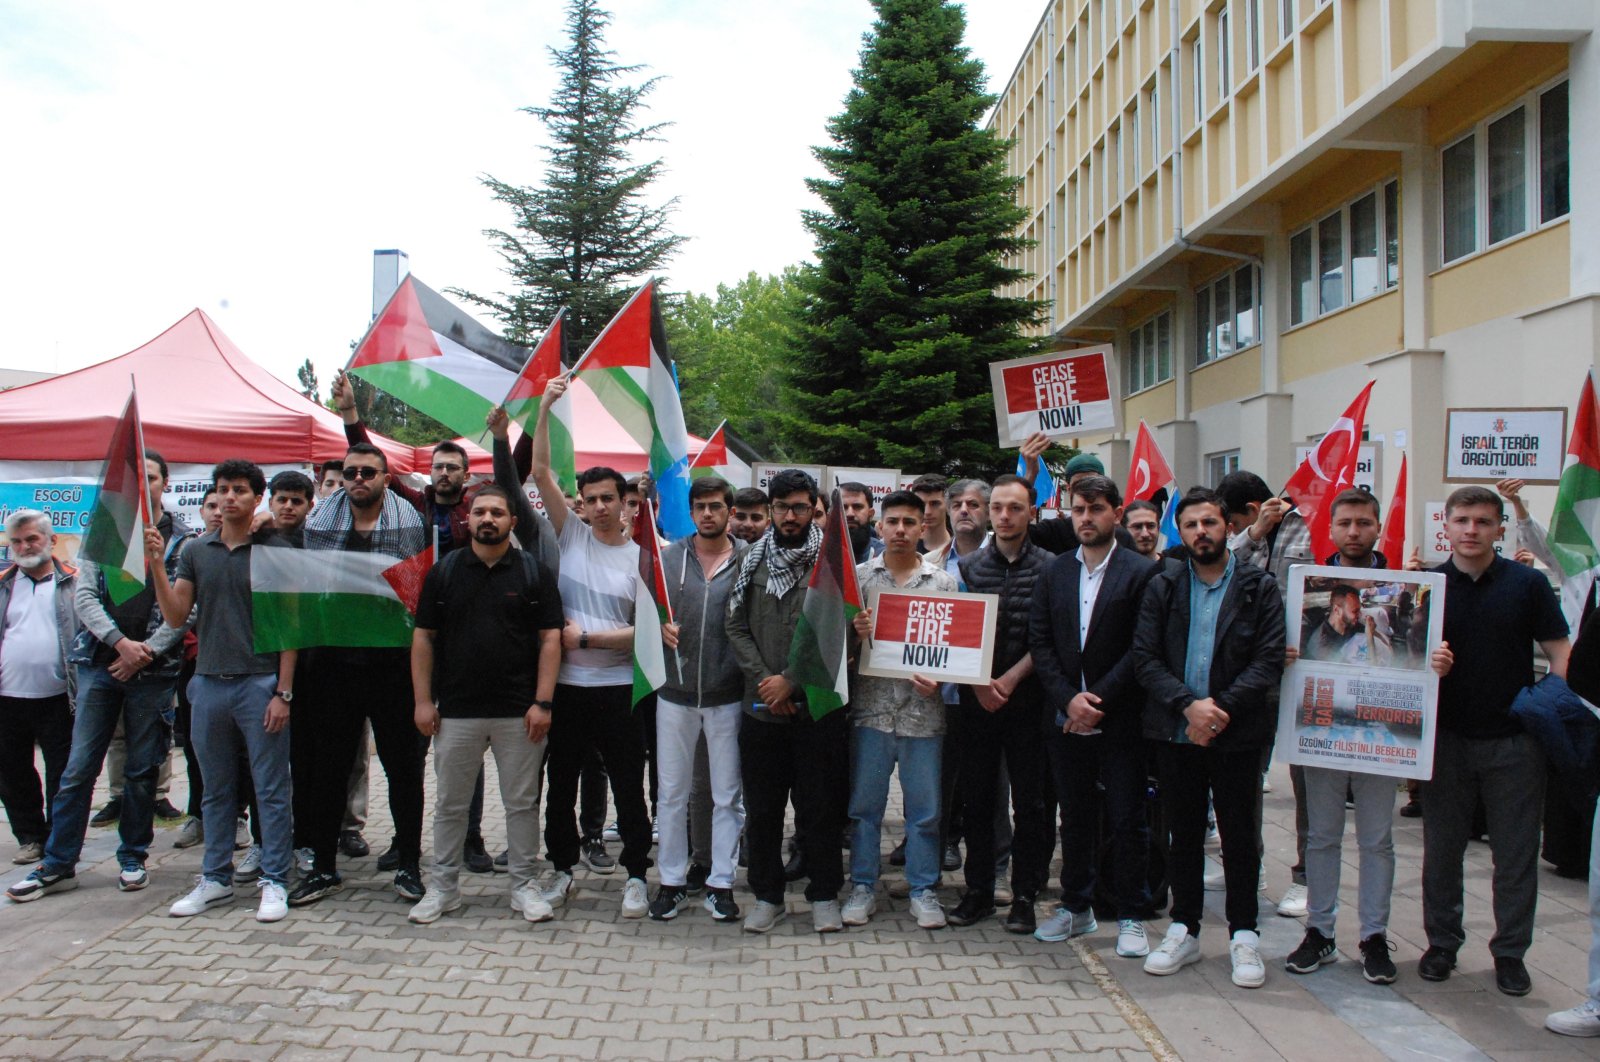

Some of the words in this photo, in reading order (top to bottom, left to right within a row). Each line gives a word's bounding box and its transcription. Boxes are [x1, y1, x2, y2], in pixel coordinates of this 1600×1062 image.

[1032, 362, 1076, 385] CEASE
[1034, 379, 1079, 410] FIRE
[1039, 405, 1082, 431] NOW!
[1461, 433, 1498, 449] İSRAİL
[1500, 433, 1539, 450] TERÖR
[1461, 450, 1537, 466] ÖRGÜTÜDÜR!
[34, 486, 82, 502] ESOGÜ
[908, 600, 954, 620] CEASE
[905, 617, 952, 646] FIRE
[902, 643, 949, 669] NOW!
[1315, 678, 1335, 727] BABIES
[1355, 704, 1422, 725] TERRORIST
[1298, 735, 1333, 750] ÜZGÜNÜZ
[1334, 739, 1373, 754] FİLİSTİNLİ
[1375, 744, 1417, 759] BEBEKLER
